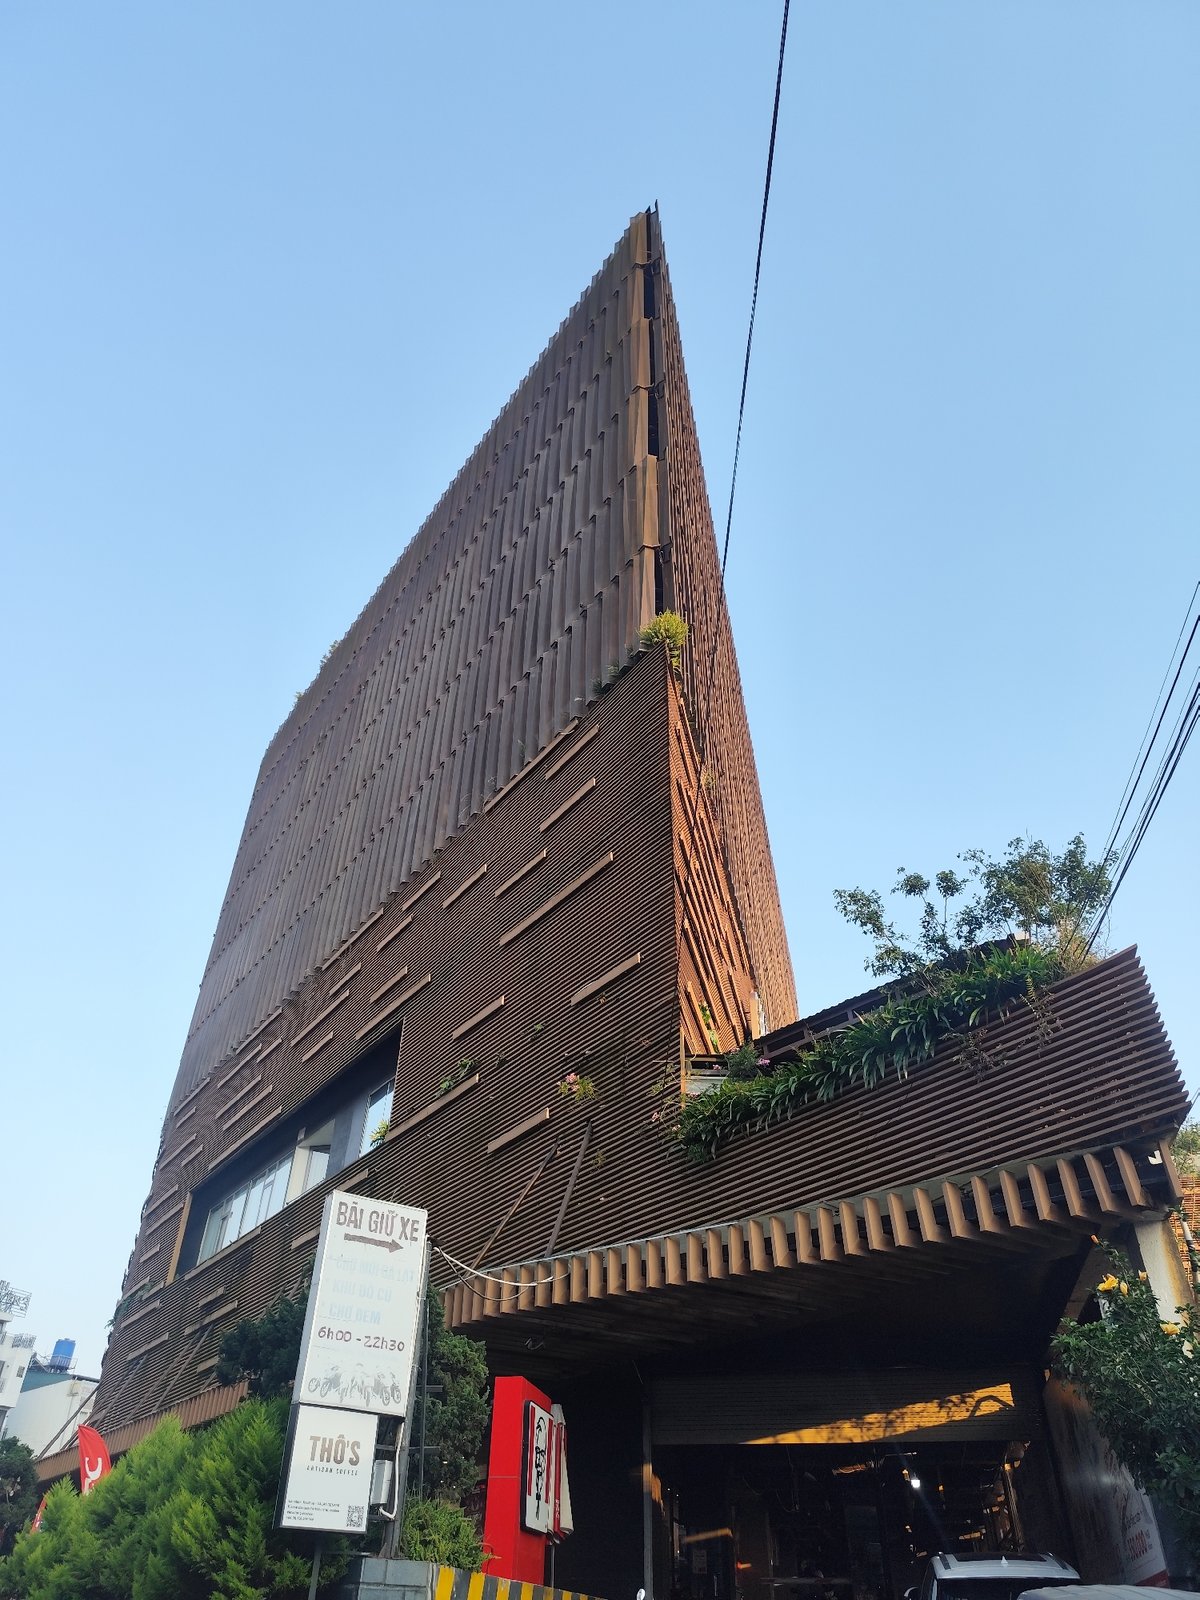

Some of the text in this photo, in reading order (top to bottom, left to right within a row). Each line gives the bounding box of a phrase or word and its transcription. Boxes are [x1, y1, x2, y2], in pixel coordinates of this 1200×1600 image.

[336, 1201, 419, 1242] BÃI GIỮ XE
[318, 1326, 352, 1342] 6h00
[364, 1335, 405, 1352] 22h30
[309, 1434, 361, 1466] THÔ'S
